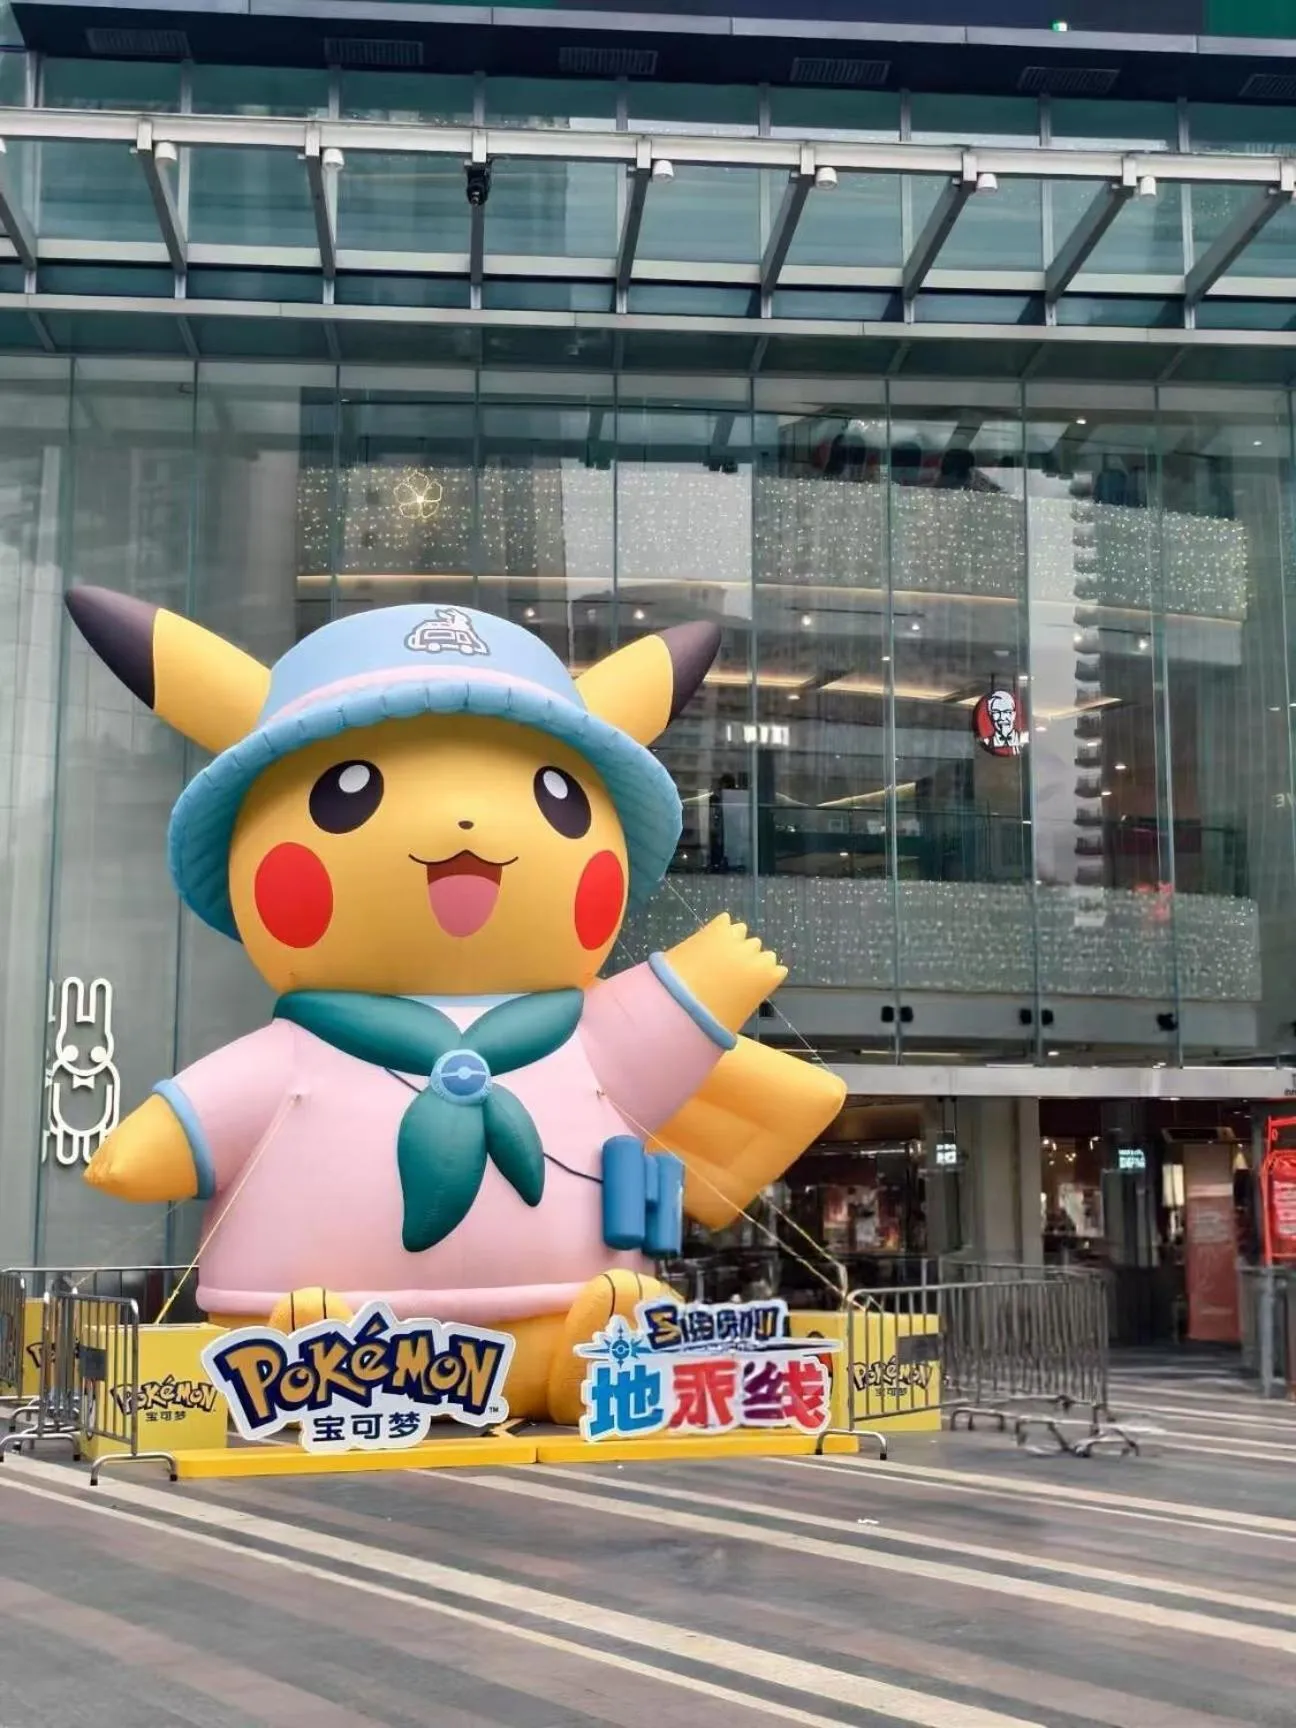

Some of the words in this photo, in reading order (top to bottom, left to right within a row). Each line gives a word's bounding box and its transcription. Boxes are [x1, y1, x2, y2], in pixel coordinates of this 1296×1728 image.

[145, 1411, 187, 1421] 宝可梦
[313, 1412, 421, 1442] 宝可梦
